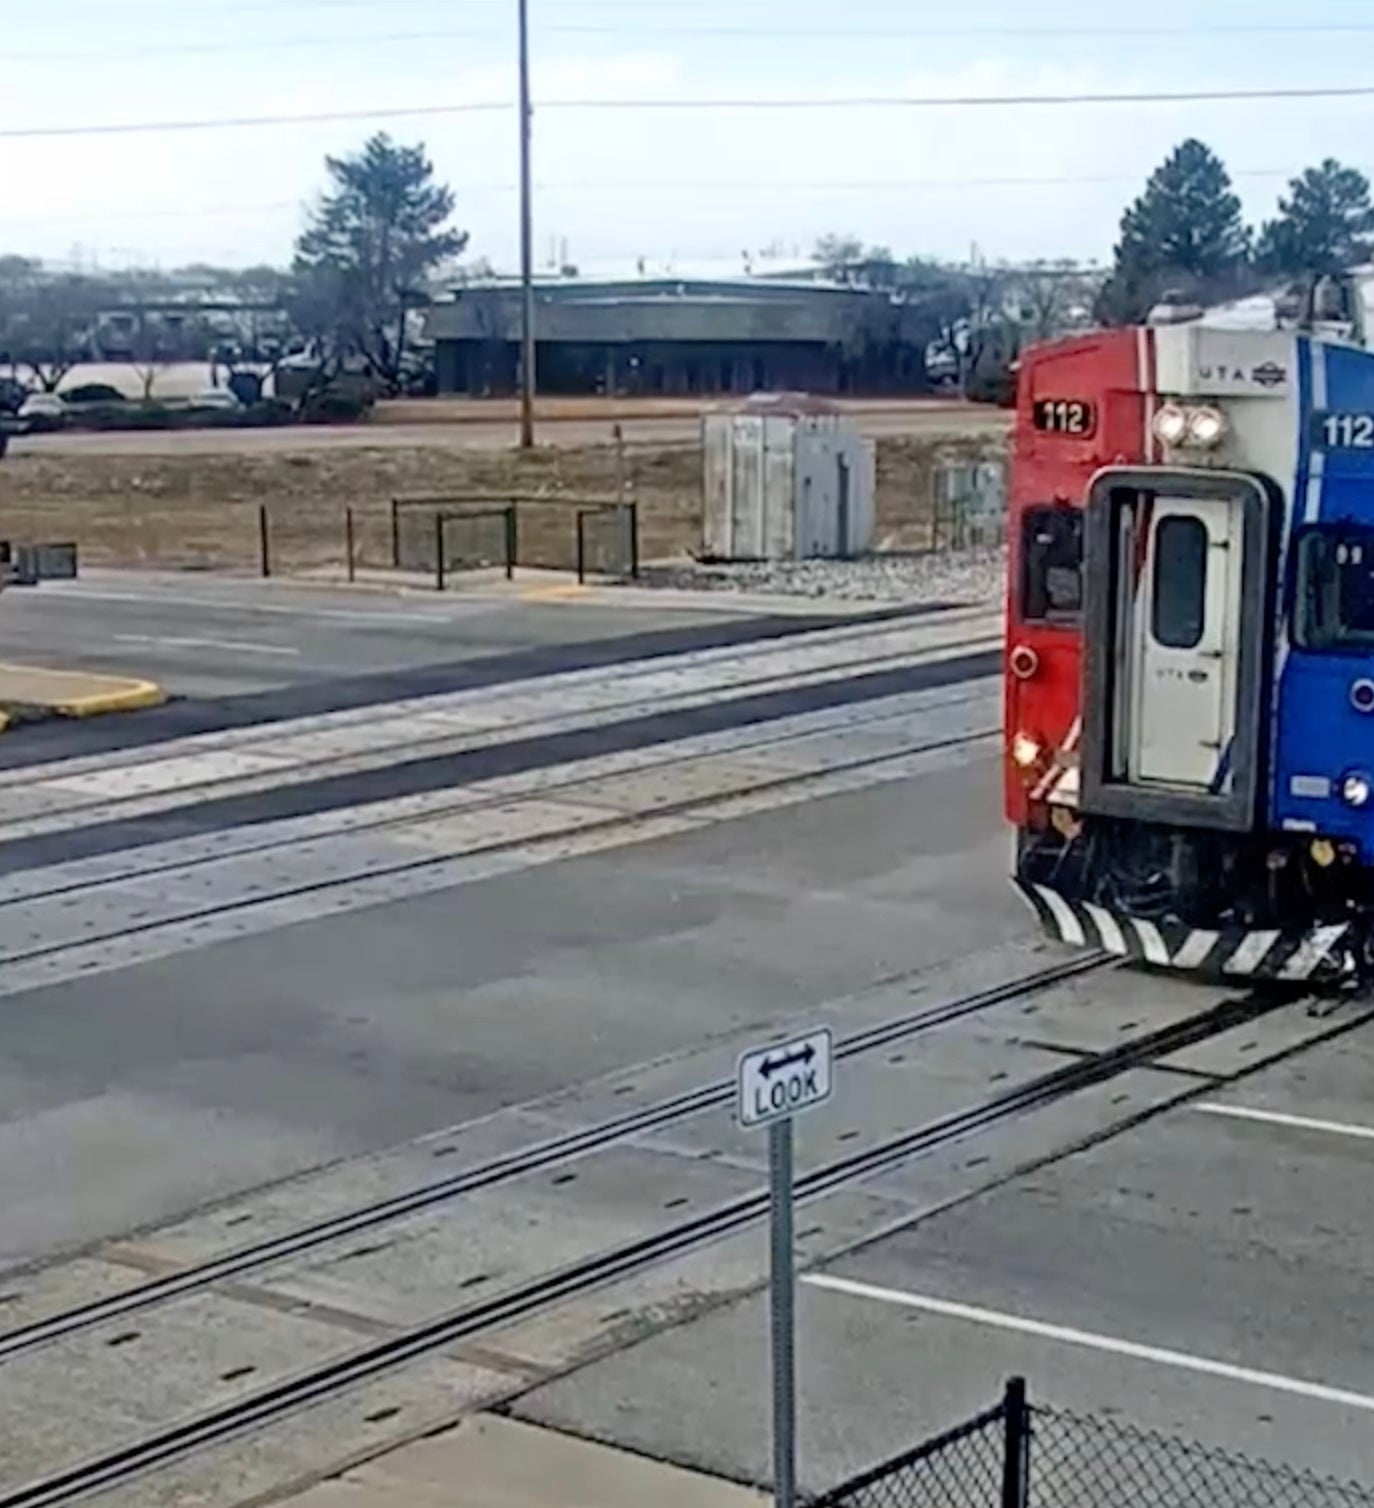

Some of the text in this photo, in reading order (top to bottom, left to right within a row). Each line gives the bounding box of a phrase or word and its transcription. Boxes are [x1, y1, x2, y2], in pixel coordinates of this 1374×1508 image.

[1199, 365, 1244, 380] UTA
[1043, 401, 1083, 433] 112
[1323, 415, 1374, 447] 112
[755, 1069, 818, 1115] LOOK
